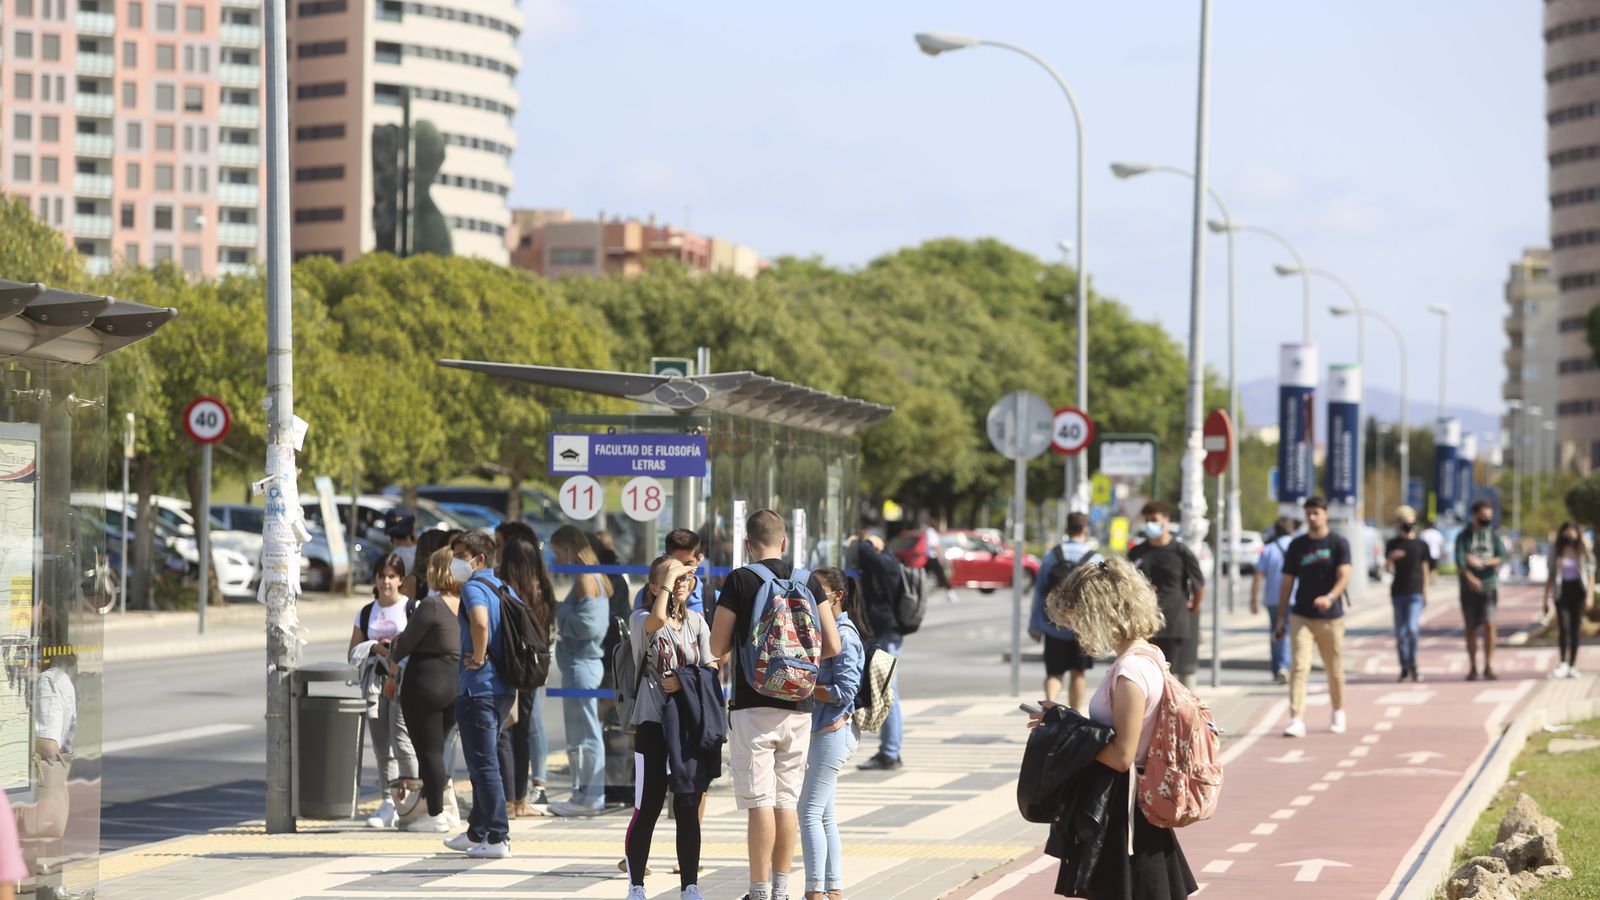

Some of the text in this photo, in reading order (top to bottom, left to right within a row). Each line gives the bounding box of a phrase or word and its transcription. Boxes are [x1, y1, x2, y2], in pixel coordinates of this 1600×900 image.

[195, 411, 218, 428] 40
[1058, 424, 1081, 440] 40
[594, 443, 701, 457] FACULTAD DE FILOSOFÍA
[632, 459, 666, 471] LETRAS
[566, 484, 594, 511] 11
[627, 485, 662, 512] 18
